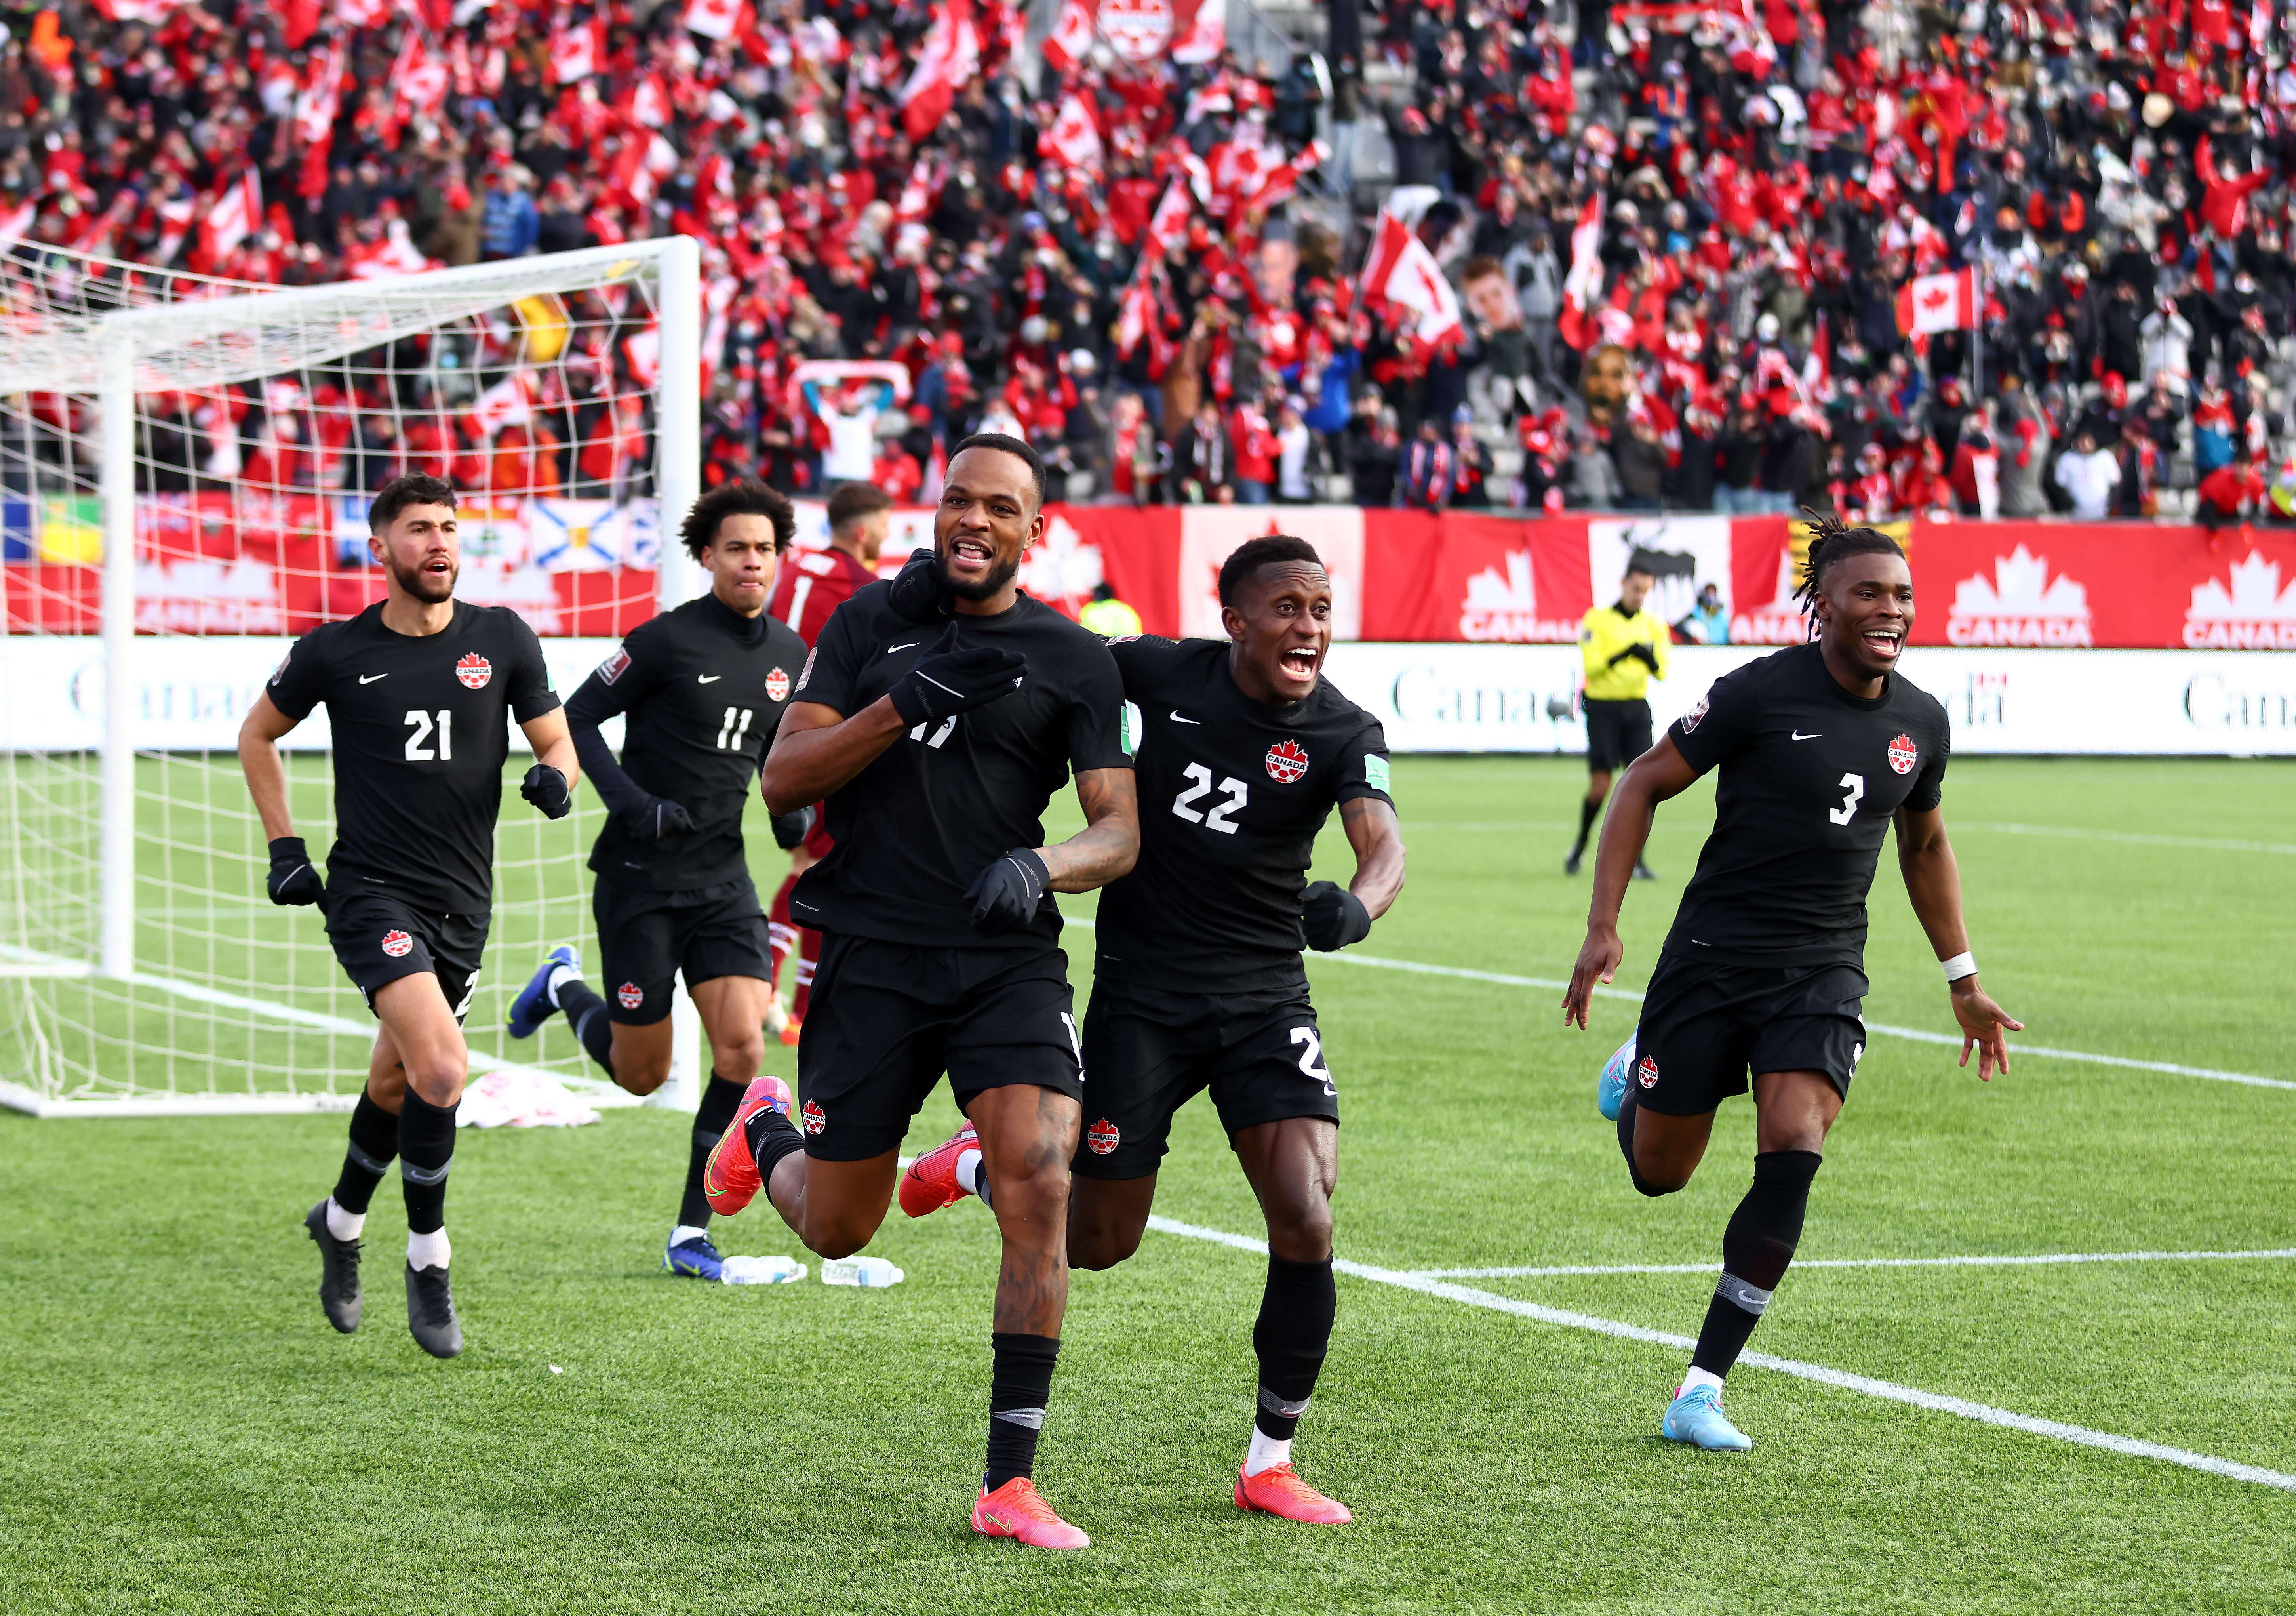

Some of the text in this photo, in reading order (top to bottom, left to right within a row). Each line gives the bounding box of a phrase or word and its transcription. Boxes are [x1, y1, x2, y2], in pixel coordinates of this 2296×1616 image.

[1946, 617, 2093, 648] CANADA
[403, 709, 451, 761] 21
[717, 706, 753, 751] 11
[1267, 754, 1305, 771] CANADA
[1889, 749, 1915, 760] CANADA
[1172, 762, 1248, 835] 22
[1829, 772, 1864, 826] 3
[1639, 1067, 1657, 1079] CANADA
[803, 1113, 824, 1122] CANADA
